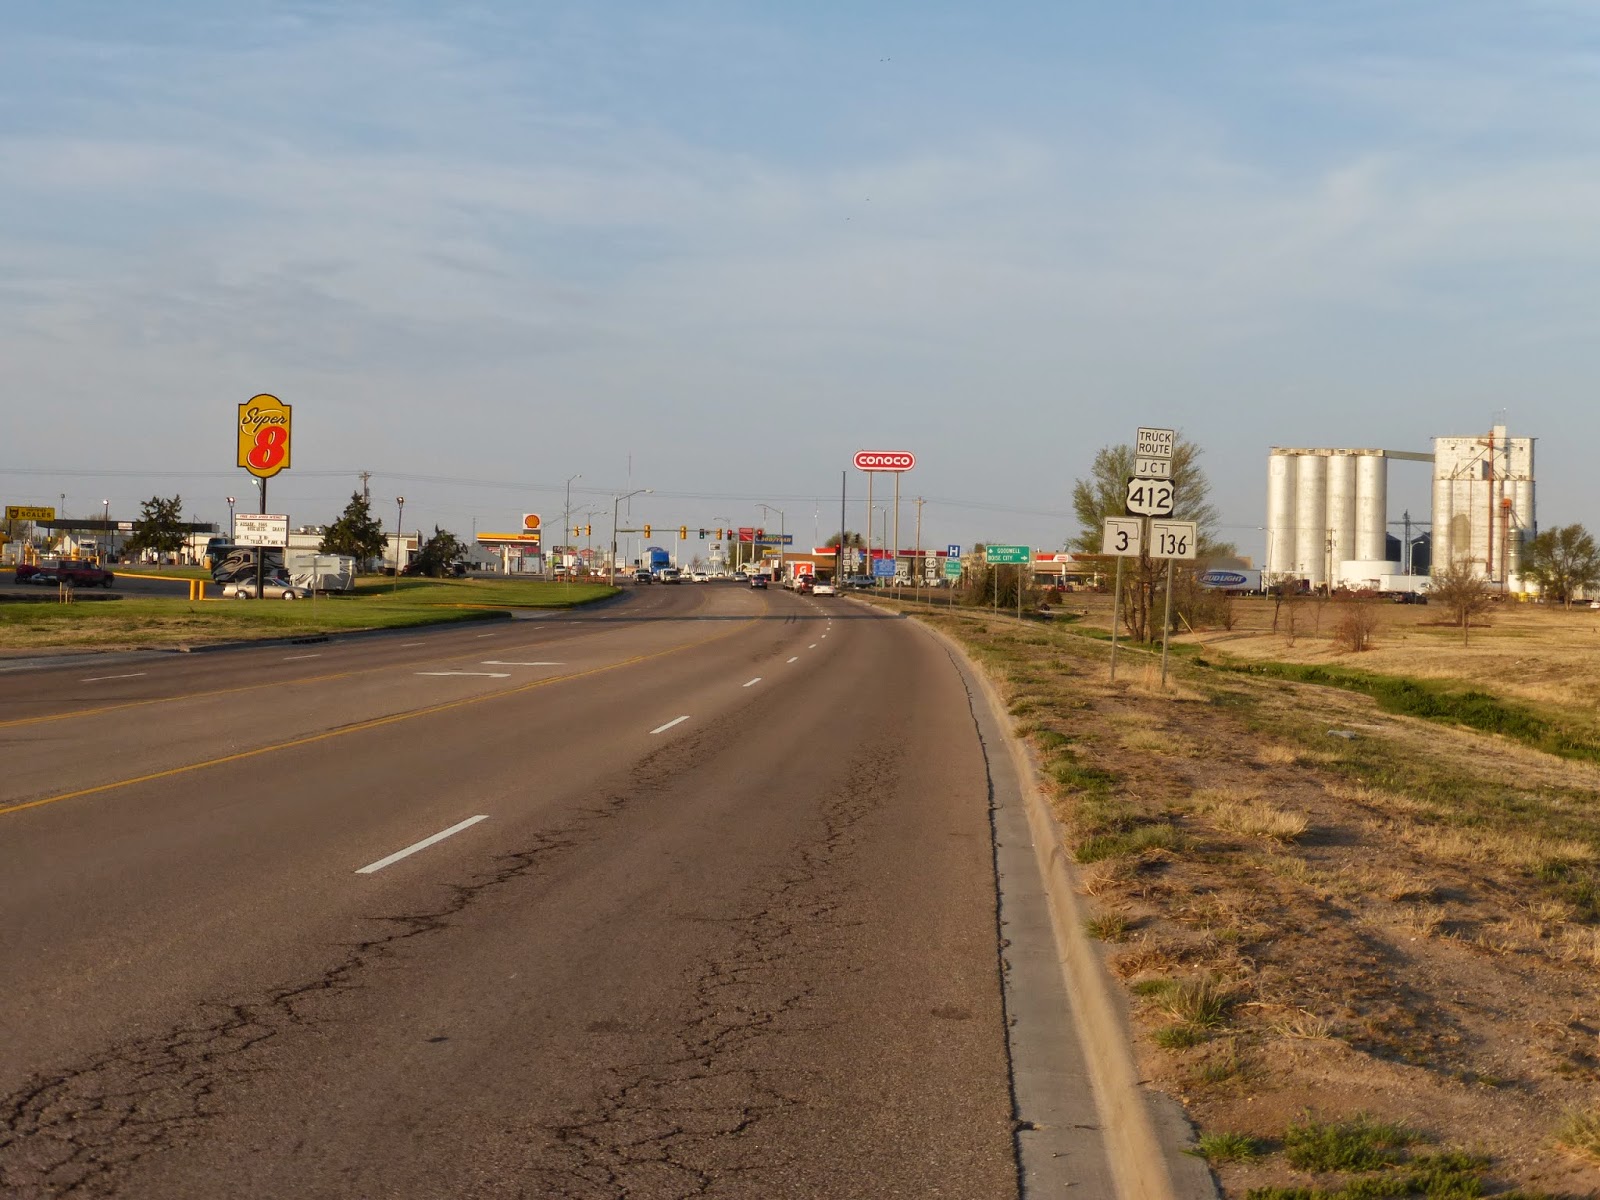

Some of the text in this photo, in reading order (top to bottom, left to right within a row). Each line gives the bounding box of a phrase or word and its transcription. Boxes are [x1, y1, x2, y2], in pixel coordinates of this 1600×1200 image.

[241, 407, 287, 434] Super
[1139, 431, 1171, 443] TRUCK
[247, 426, 287, 470] 8
[1138, 443, 1170, 455] ROUTE
[858, 455, 910, 466] conoco
[1140, 462, 1167, 473] JCT
[1130, 486, 1171, 509] 412
[1115, 530, 1129, 552] 3
[1159, 533, 1187, 555] 136
[949, 546, 959, 557] H
[895, 570, 907, 578] 40
